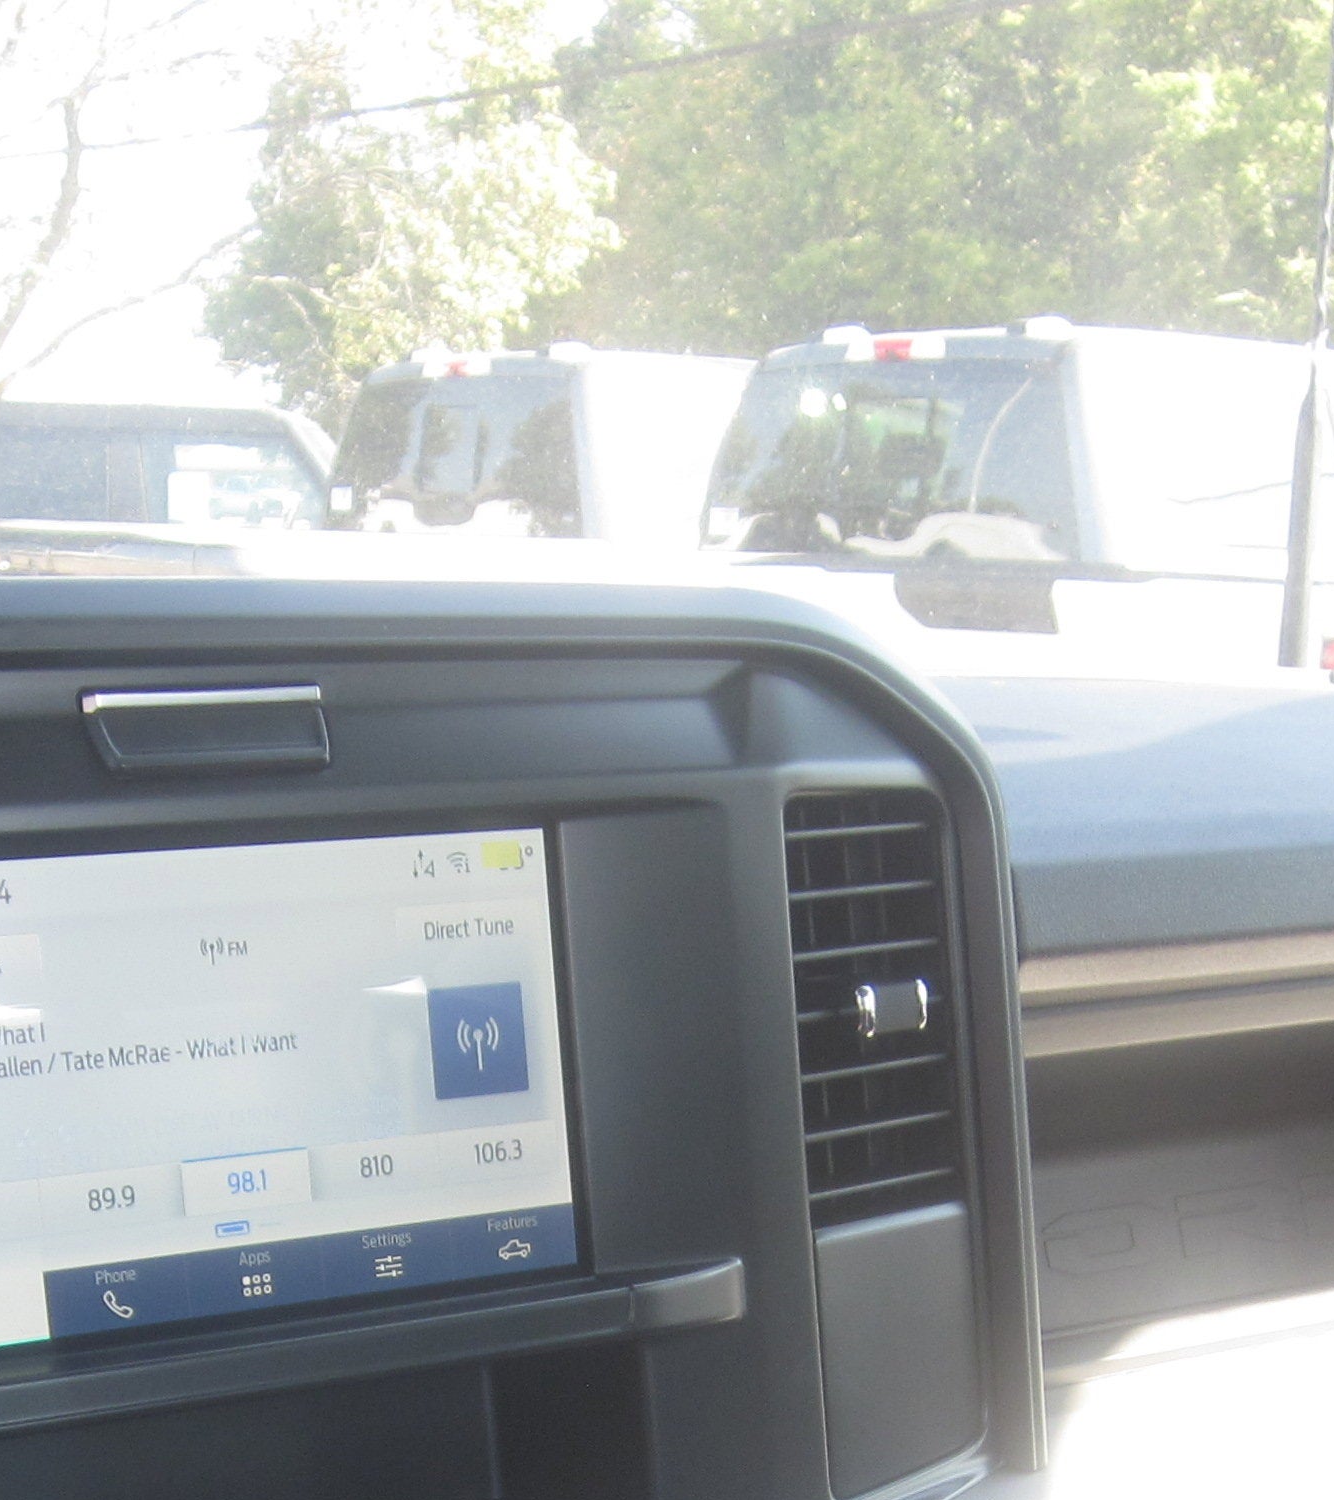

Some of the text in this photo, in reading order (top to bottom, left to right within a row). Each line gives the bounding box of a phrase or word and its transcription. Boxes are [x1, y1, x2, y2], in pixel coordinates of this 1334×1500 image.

[227, 940, 248, 957] FM
[423, 917, 515, 942] Direct Tune
[61, 1051, 104, 1073] Tate
[186, 1037, 237, 1060] What
[251, 1033, 298, 1054] Want
[87, 1185, 136, 1212] 89.9
[227, 1168, 268, 1194] 98.1
[359, 1154, 394, 1179] 810
[473, 1138, 523, 1165] 106.3
[94, 1267, 137, 1286] Phone
[238, 1250, 271, 1268] Apps
[361, 1231, 412, 1250] Settings
[486, 1213, 539, 1233] Features
